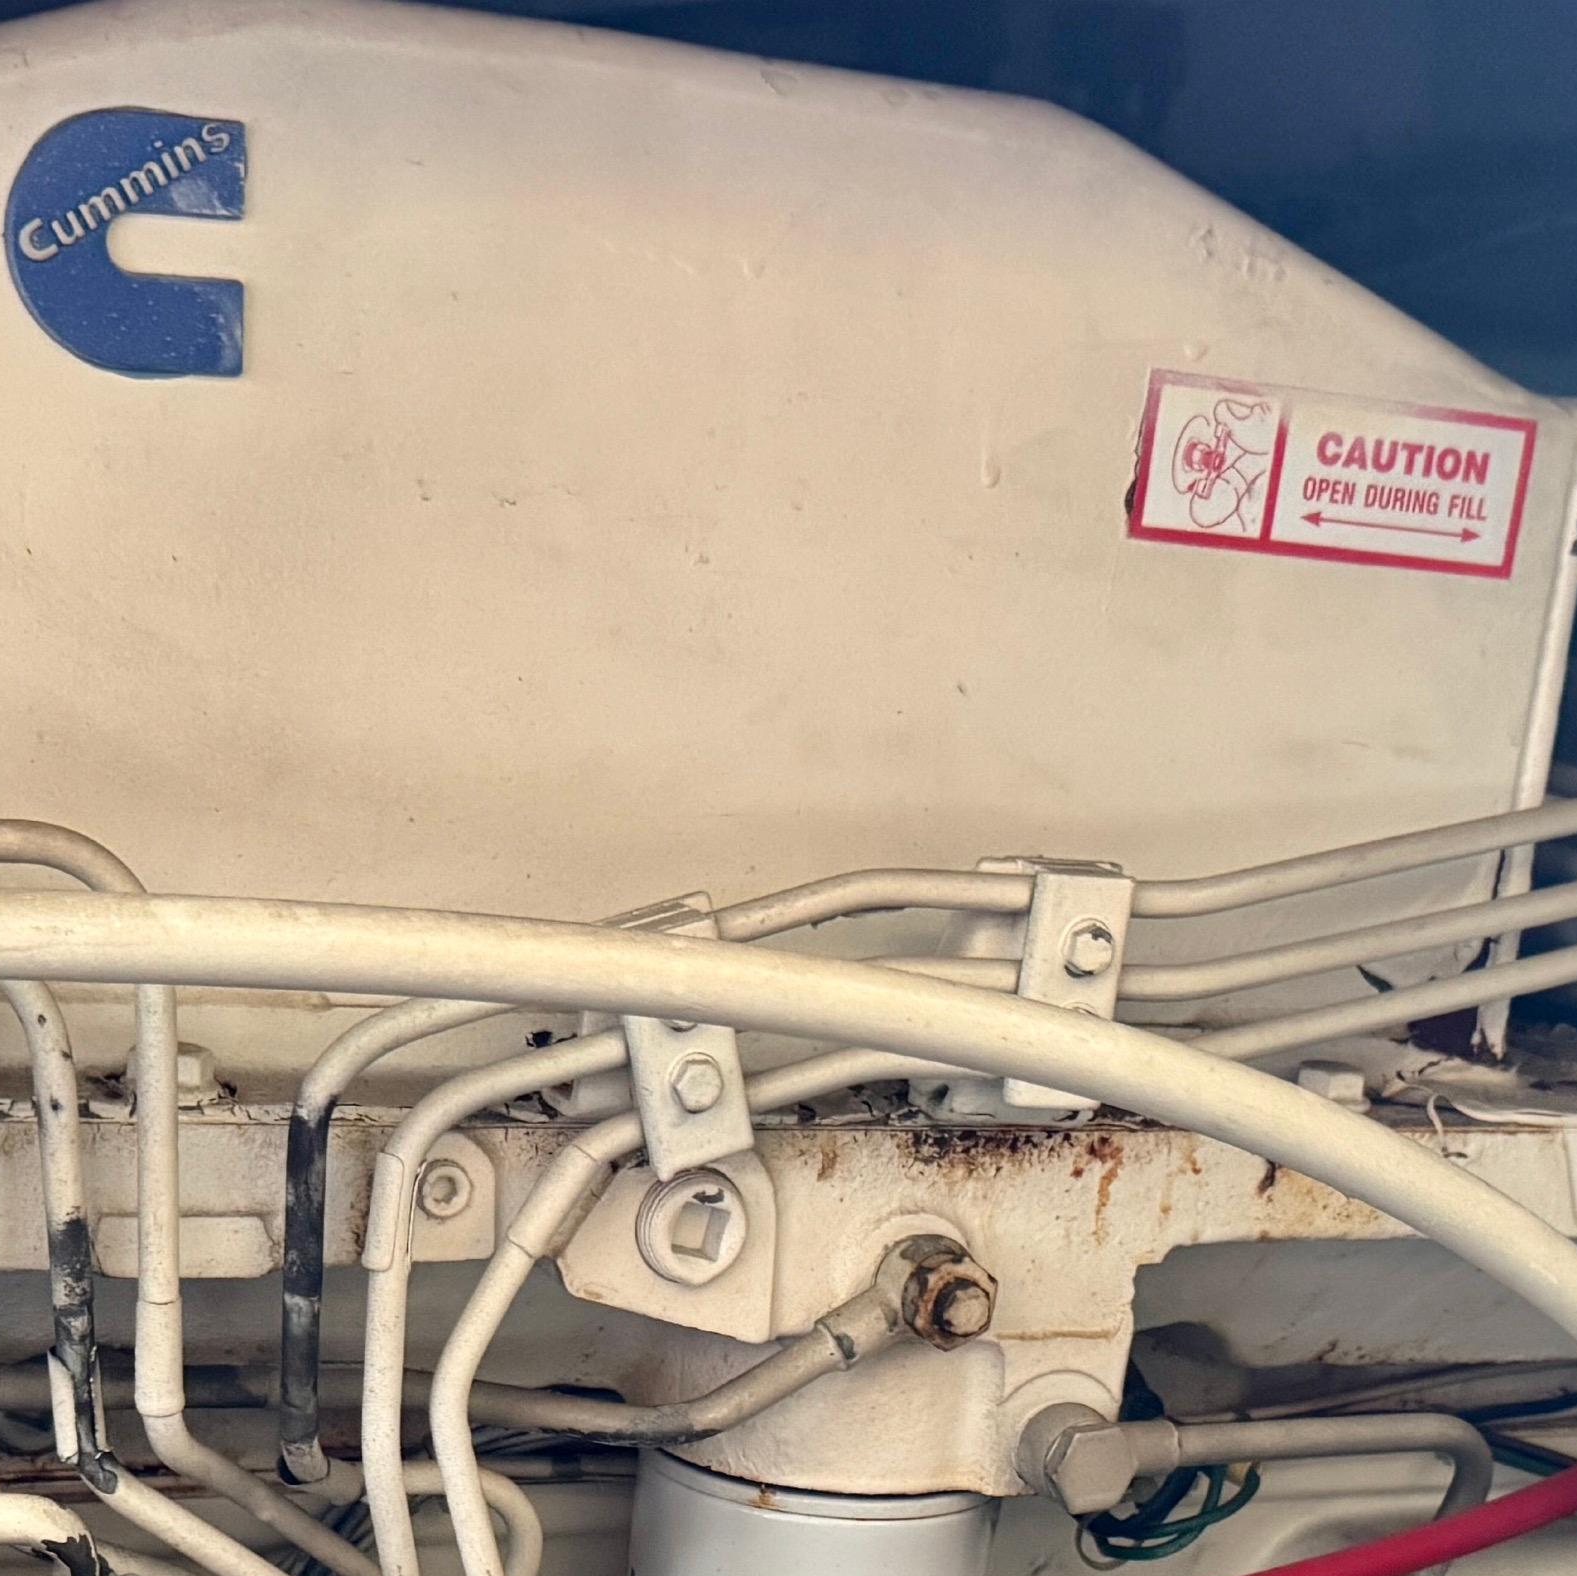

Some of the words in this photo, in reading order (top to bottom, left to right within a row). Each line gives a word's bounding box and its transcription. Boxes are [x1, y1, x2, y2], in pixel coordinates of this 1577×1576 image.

[18, 122, 231, 263] Cummins
[1315, 431, 1491, 486] CAUTION
[1302, 475, 1357, 505] OPEN
[1362, 483, 1439, 516] DURING
[1447, 495, 1488, 522] FILL
